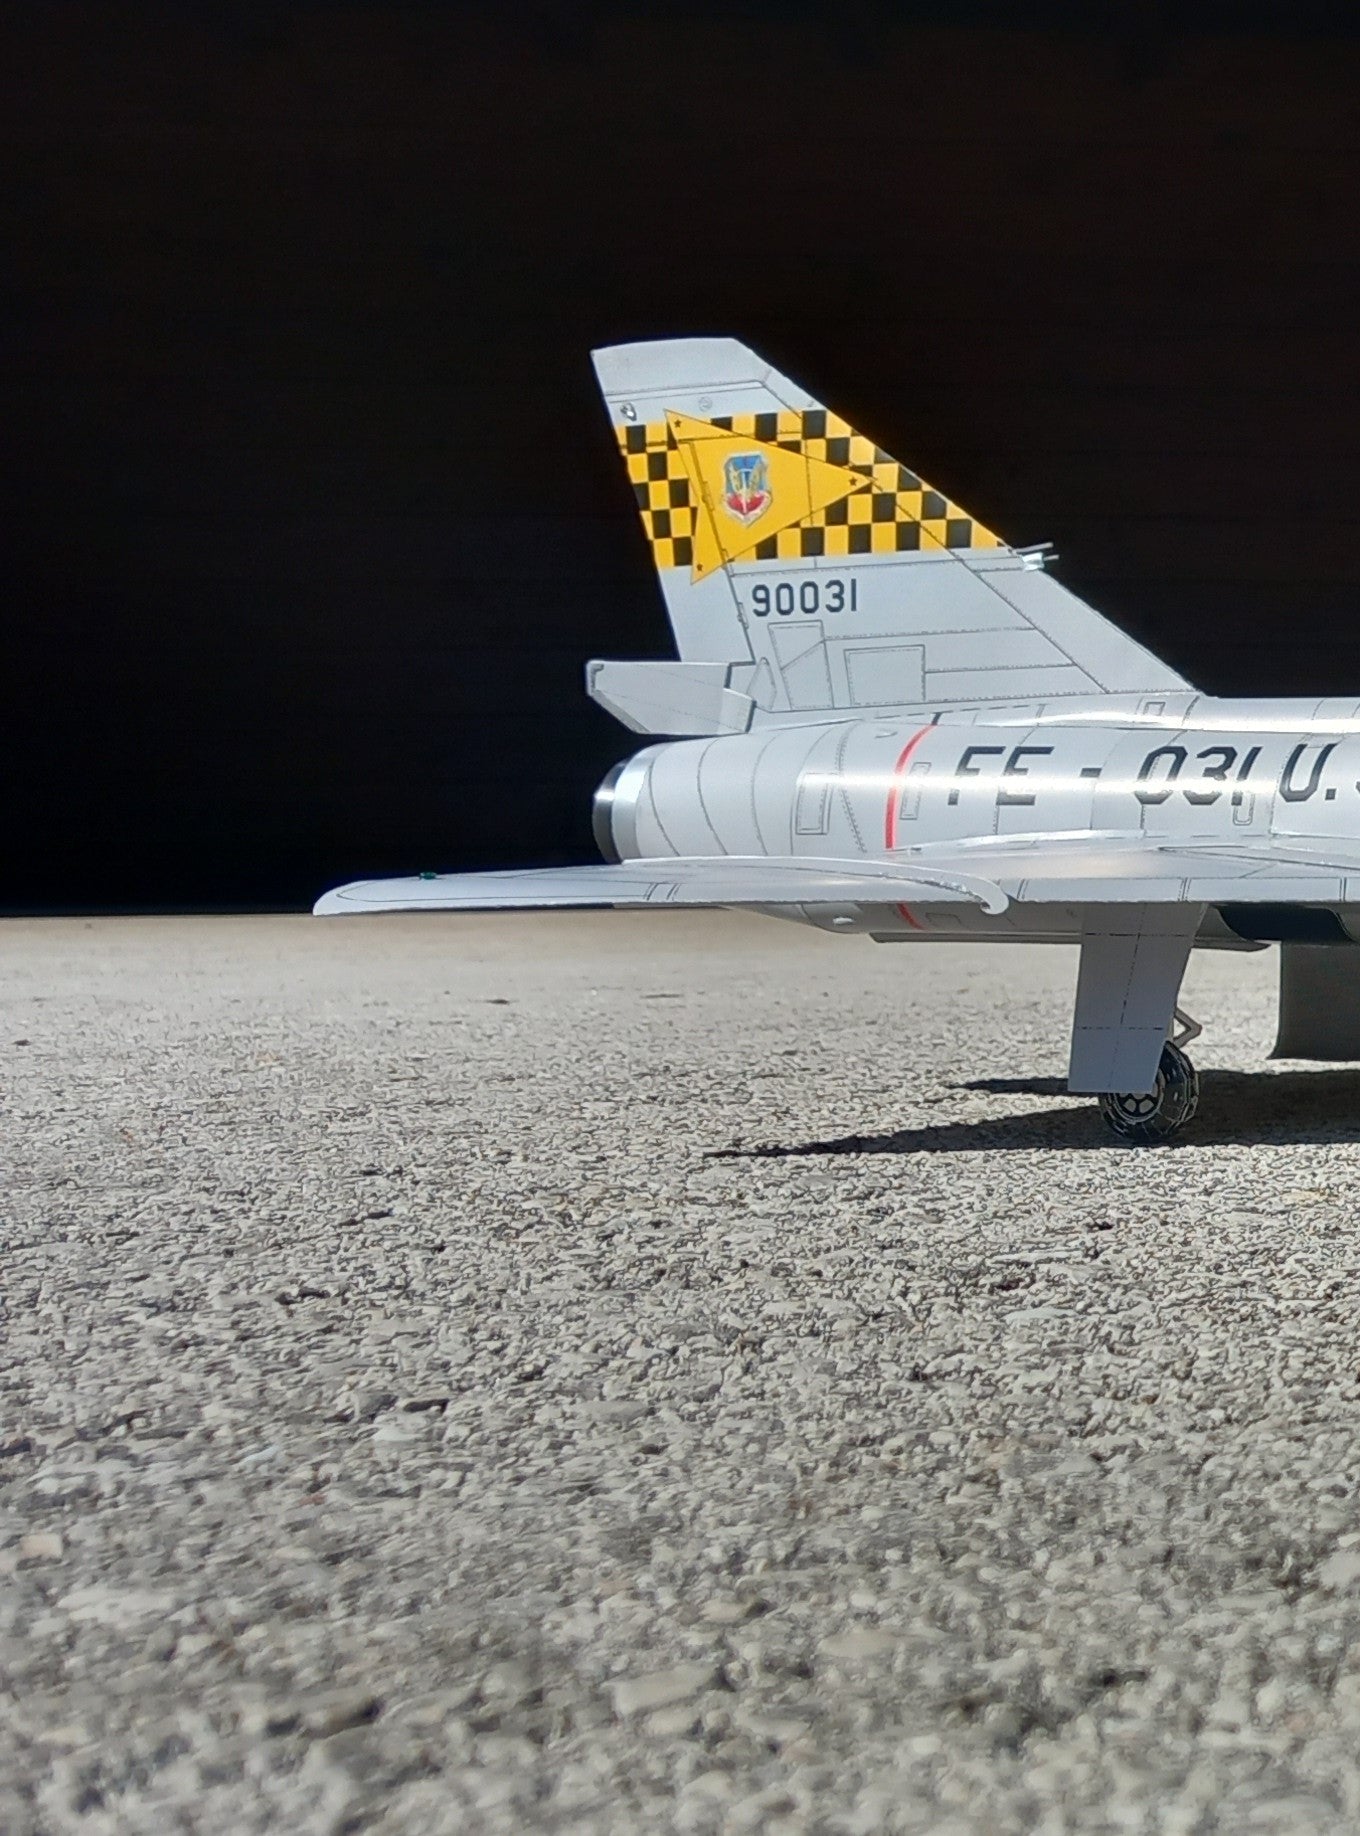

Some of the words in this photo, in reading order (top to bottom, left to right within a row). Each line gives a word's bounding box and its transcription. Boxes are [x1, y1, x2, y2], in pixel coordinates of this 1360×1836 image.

[752, 578, 857, 617] 90031
[947, 746, 1054, 806] FE
[1134, 746, 1263, 806] 031
